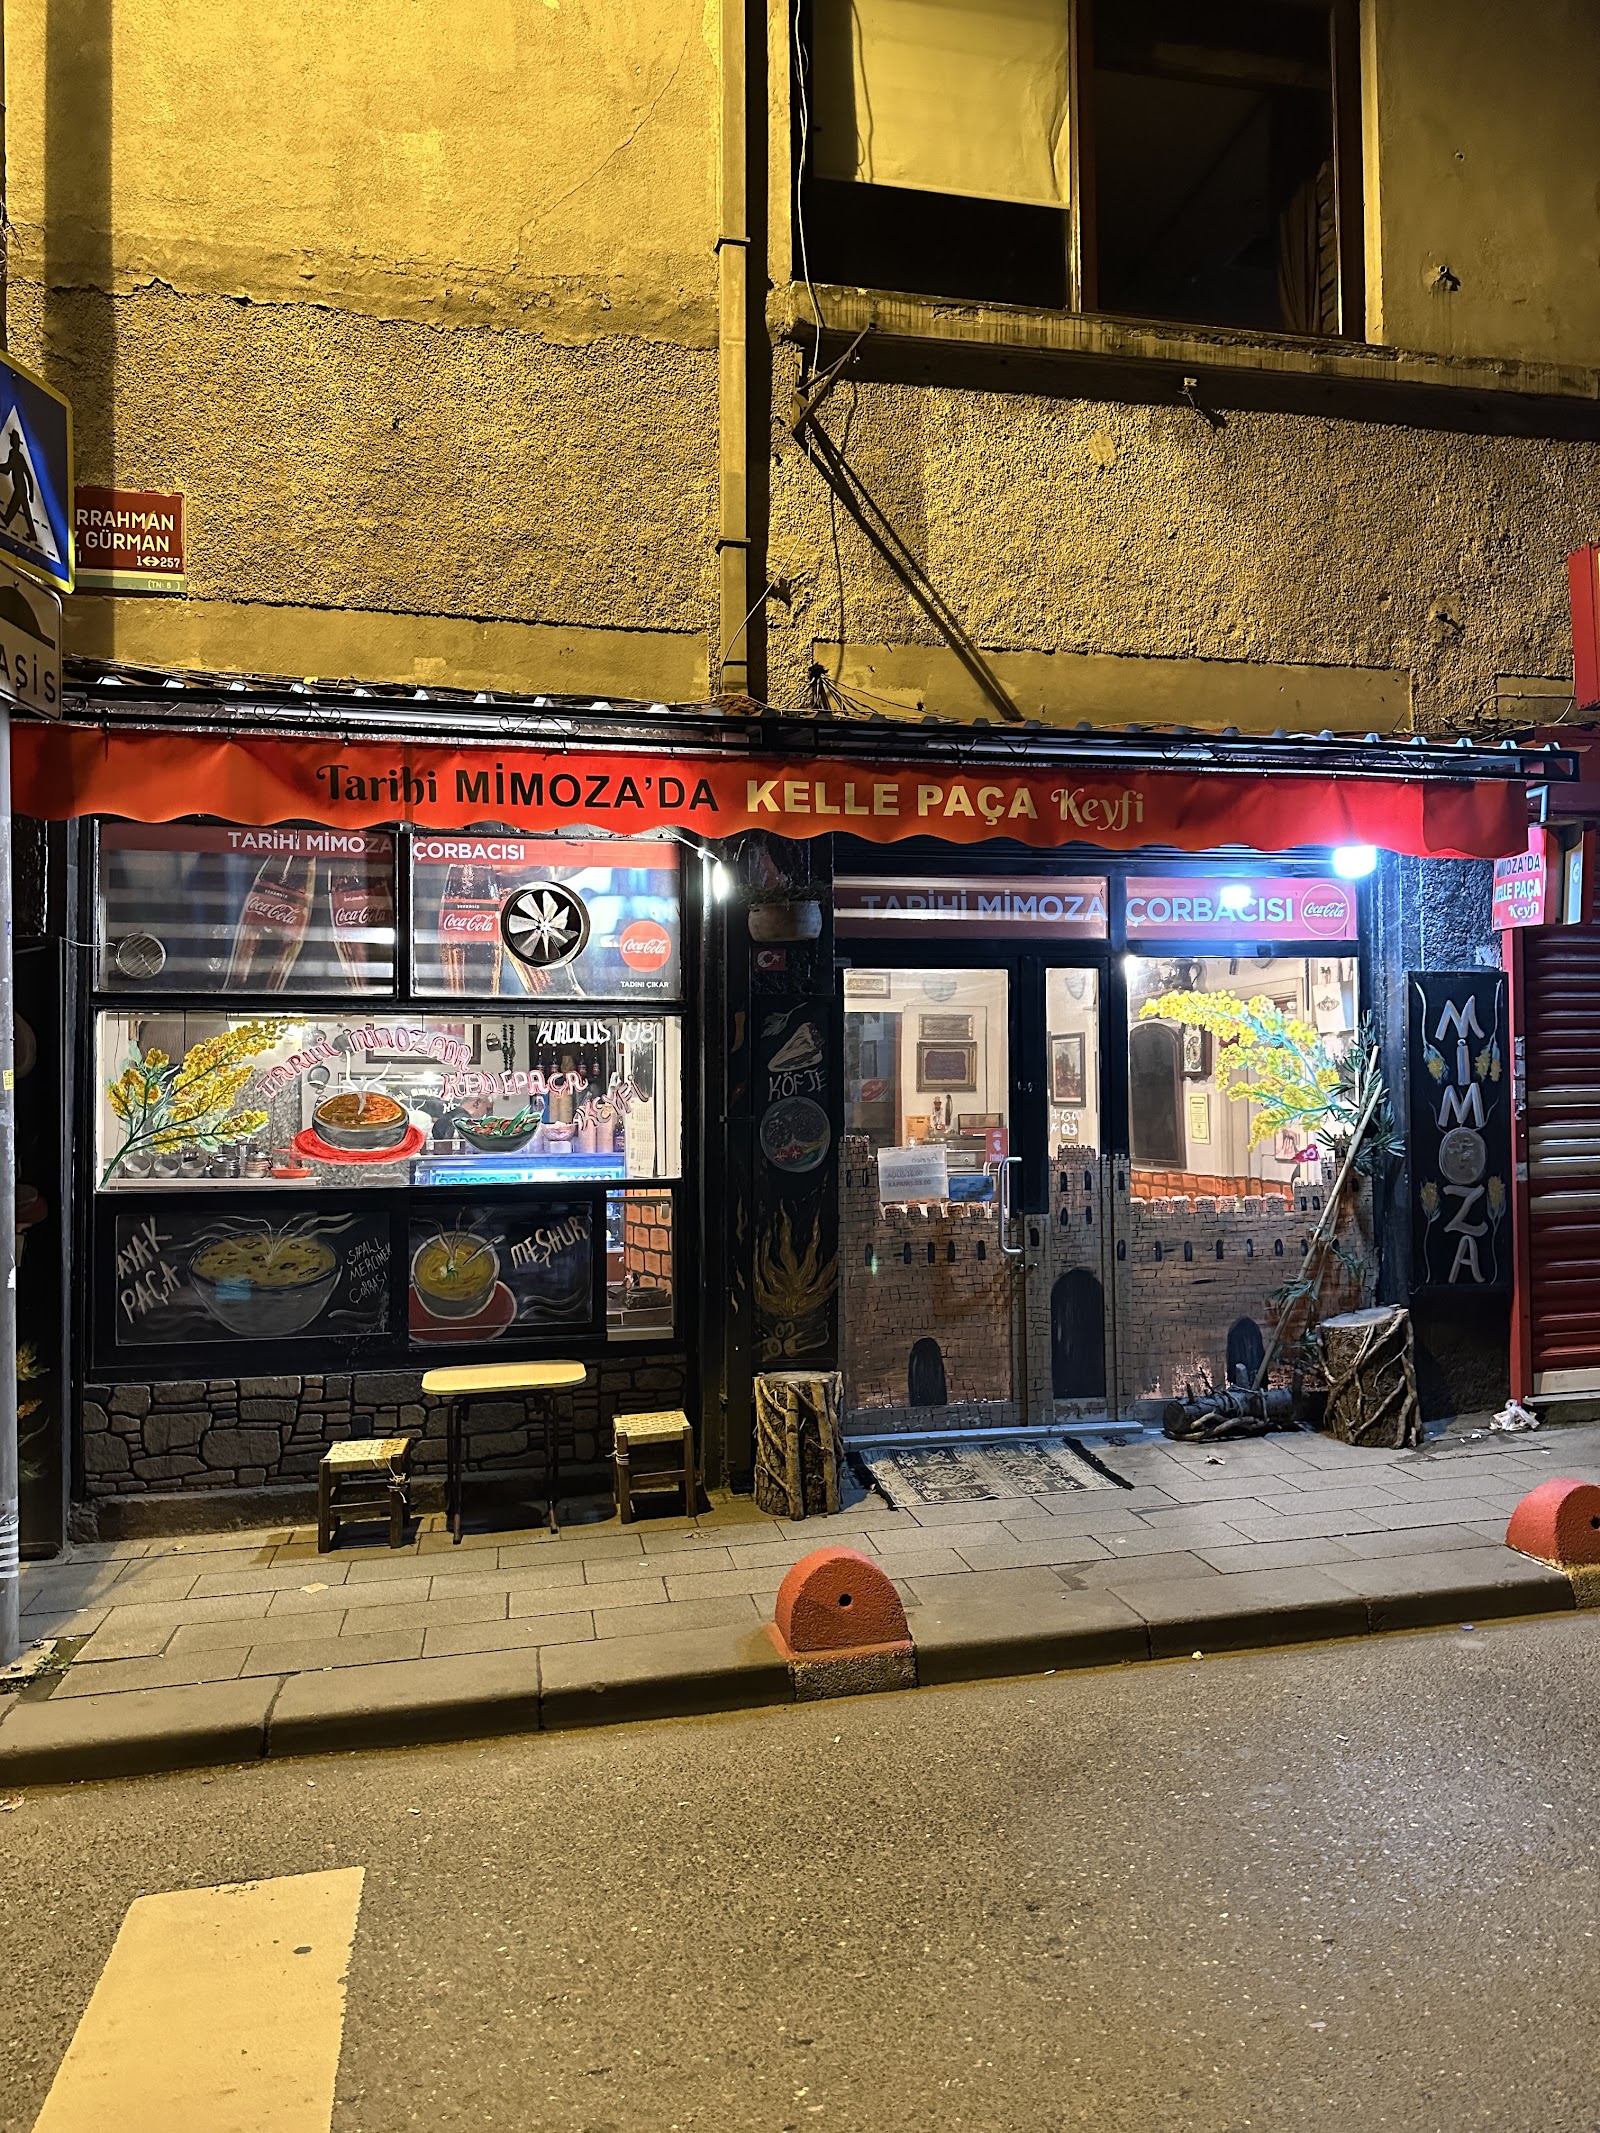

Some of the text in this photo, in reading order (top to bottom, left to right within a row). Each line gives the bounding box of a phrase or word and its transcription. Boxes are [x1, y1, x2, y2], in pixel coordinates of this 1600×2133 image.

[77, 509, 174, 531] RRAHMAN
[86, 529, 169, 552] GÜRMAN
[160, 557, 180, 568] 257
[316, 763, 1145, 831] Tarihi MİMOZA'DA KELLE PAÇA Keyfi
[227, 830, 525, 861] TARİHİ MİMOZA ÇORBACISI
[1514, 878, 1541, 902] PAÇA
[246, 896, 300, 925] Coca-Cola
[860, 889, 1292, 927] TARİHİ MİMOZA ÇORBACISI
[1303, 901, 1346, 918] Coca-Cola
[1508, 901, 1540, 918] Keyfi
[443, 913, 494, 931] Coca-Cola
[622, 938, 668, 954] Coca-Cola
[646, 981, 669, 989] ÇIKAR
[117, 1214, 173, 1280] AYAK
